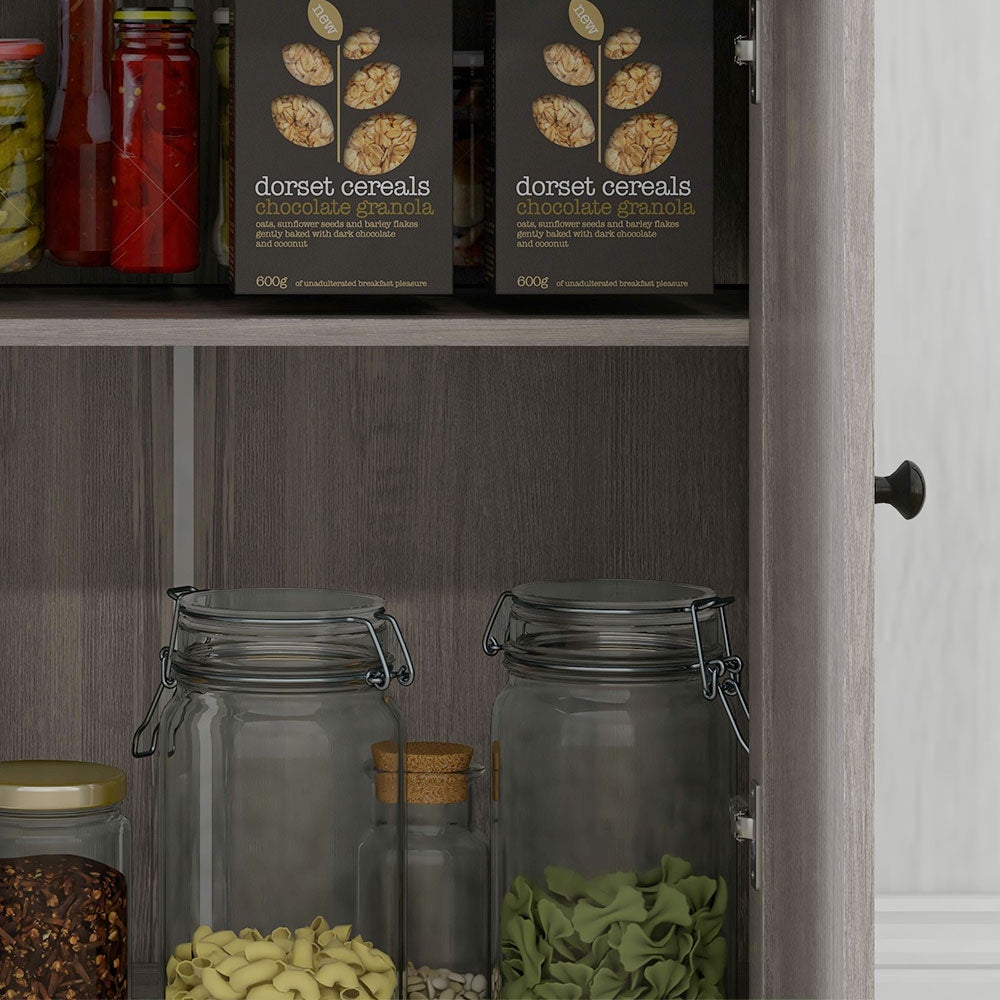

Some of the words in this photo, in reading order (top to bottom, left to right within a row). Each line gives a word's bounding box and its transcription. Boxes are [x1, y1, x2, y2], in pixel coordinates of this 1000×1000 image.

[312, 4, 338, 35] new
[573, 4, 599, 35] new
[255, 176, 335, 197] dorset
[341, 176, 431, 197] cereals
[516, 176, 596, 197] dorset
[602, 176, 692, 197] cereals
[255, 198, 351, 216] chocolate
[356, 198, 435, 218] granola
[516, 198, 612, 216] chocolate
[617, 198, 696, 218] granola
[277, 220, 319, 229] sunflower
[321, 220, 344, 229] seeds
[346, 220, 362, 229] and
[364, 220, 391, 231] barley
[393, 220, 419, 229] flakes
[538, 220, 580, 229] sunflower
[582, 220, 605, 229] seeds
[607, 220, 623, 229] and
[625, 220, 652, 231] barley
[654, 220, 680, 229] flakes
[255, 230, 283, 241] gently
[285, 230, 310, 239] baked
[312, 230, 332, 239] with
[333, 230, 354, 239] dark
[355, 230, 396, 239] chocolate
[516, 230, 544, 241] gently
[546, 230, 571, 239] baked
[573, 230, 593, 239] with
[594, 230, 615, 239] dark
[616, 230, 657, 239] chocolate
[255, 239, 272, 248] and
[274, 239, 309, 248] coconut
[516, 239, 533, 248] and
[535, 239, 570, 248] coconut
[255, 276, 288, 289] 600g
[295, 279, 303, 288] of
[304, 279, 357, 288] unadulterated
[358, 279, 394, 288] breakfast
[395, 279, 428, 289] pleasure
[516, 276, 549, 289] 600g
[556, 279, 564, 288] of
[565, 279, 618, 288] unadulterated
[619, 279, 655, 288] breakfast
[656, 279, 689, 289] pleasure
